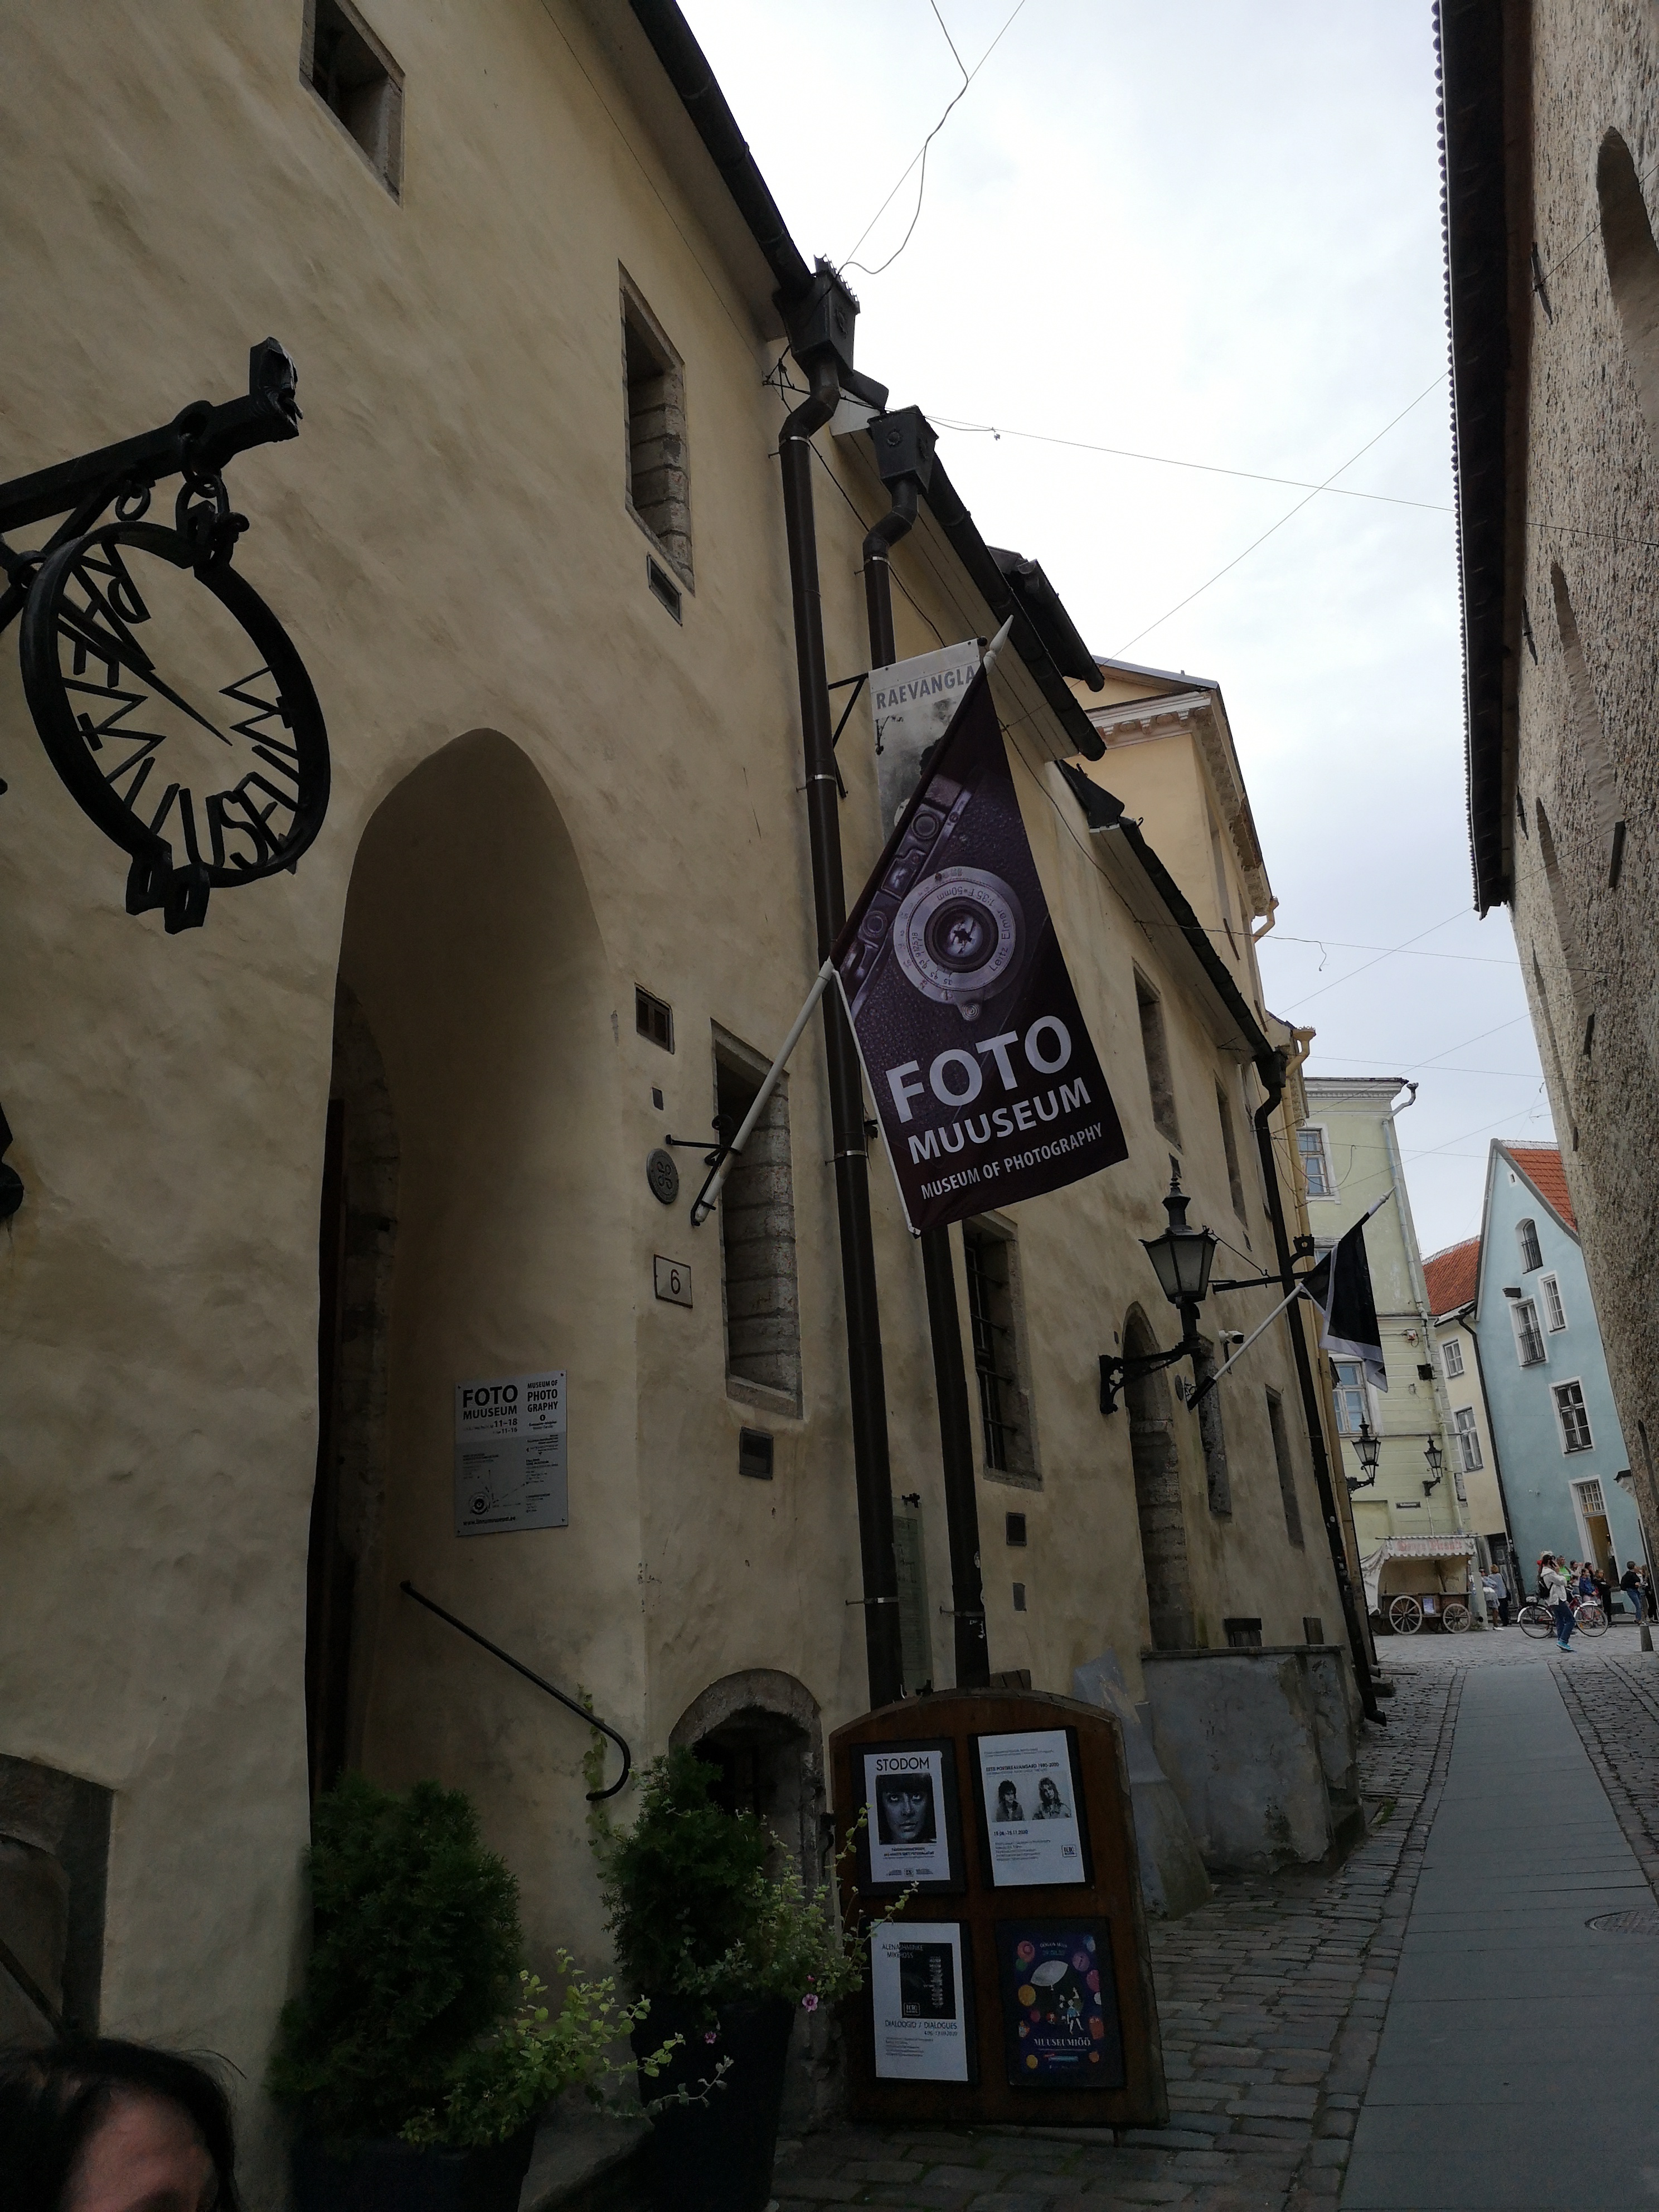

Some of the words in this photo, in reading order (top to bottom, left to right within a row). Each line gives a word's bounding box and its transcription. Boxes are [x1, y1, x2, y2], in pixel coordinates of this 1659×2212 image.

[876, 665, 975, 709] RAEVANGLA
[886, 1015, 1071, 1123] FOTO
[908, 1077, 1092, 1165] MUUSEUM
[920, 1168, 981, 1200] MUSEUM
[983, 1161, 1001, 1179] OF
[1004, 1122, 1102, 1173] PHOTOGRAPHY
[671, 1269, 681, 1294] 6
[527, 1380, 551, 1389] MUSEUM
[527, 1389, 558, 1402] PHOTO
[463, 1385, 518, 1408] FOTO
[527, 1401, 558, 1413] GRAPHY
[463, 1405, 517, 1420] MUUSEUM
[876, 1757, 929, 1771] STODOM
